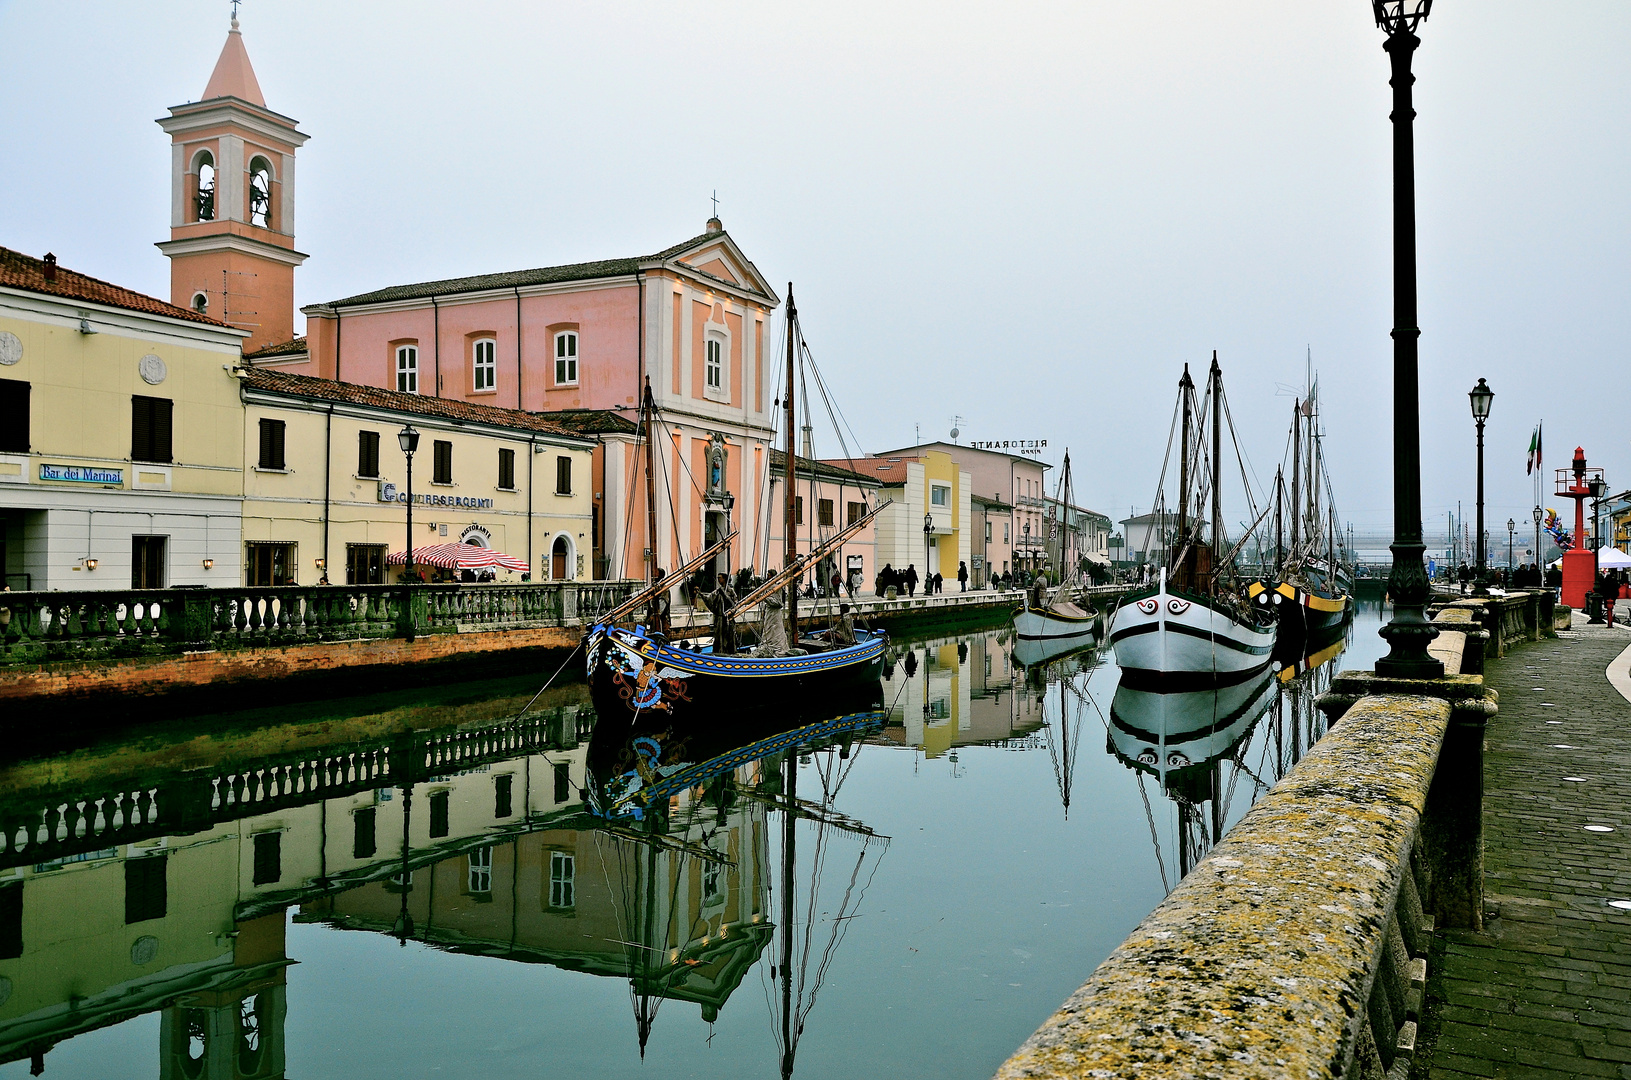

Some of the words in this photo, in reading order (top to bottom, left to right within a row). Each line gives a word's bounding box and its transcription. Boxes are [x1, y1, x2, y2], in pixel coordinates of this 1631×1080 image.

[43, 465, 60, 479] Bar
[63, 467, 79, 480] dei
[83, 468, 120, 482] Marinai
[460, 524, 492, 539] RISTORANTE
